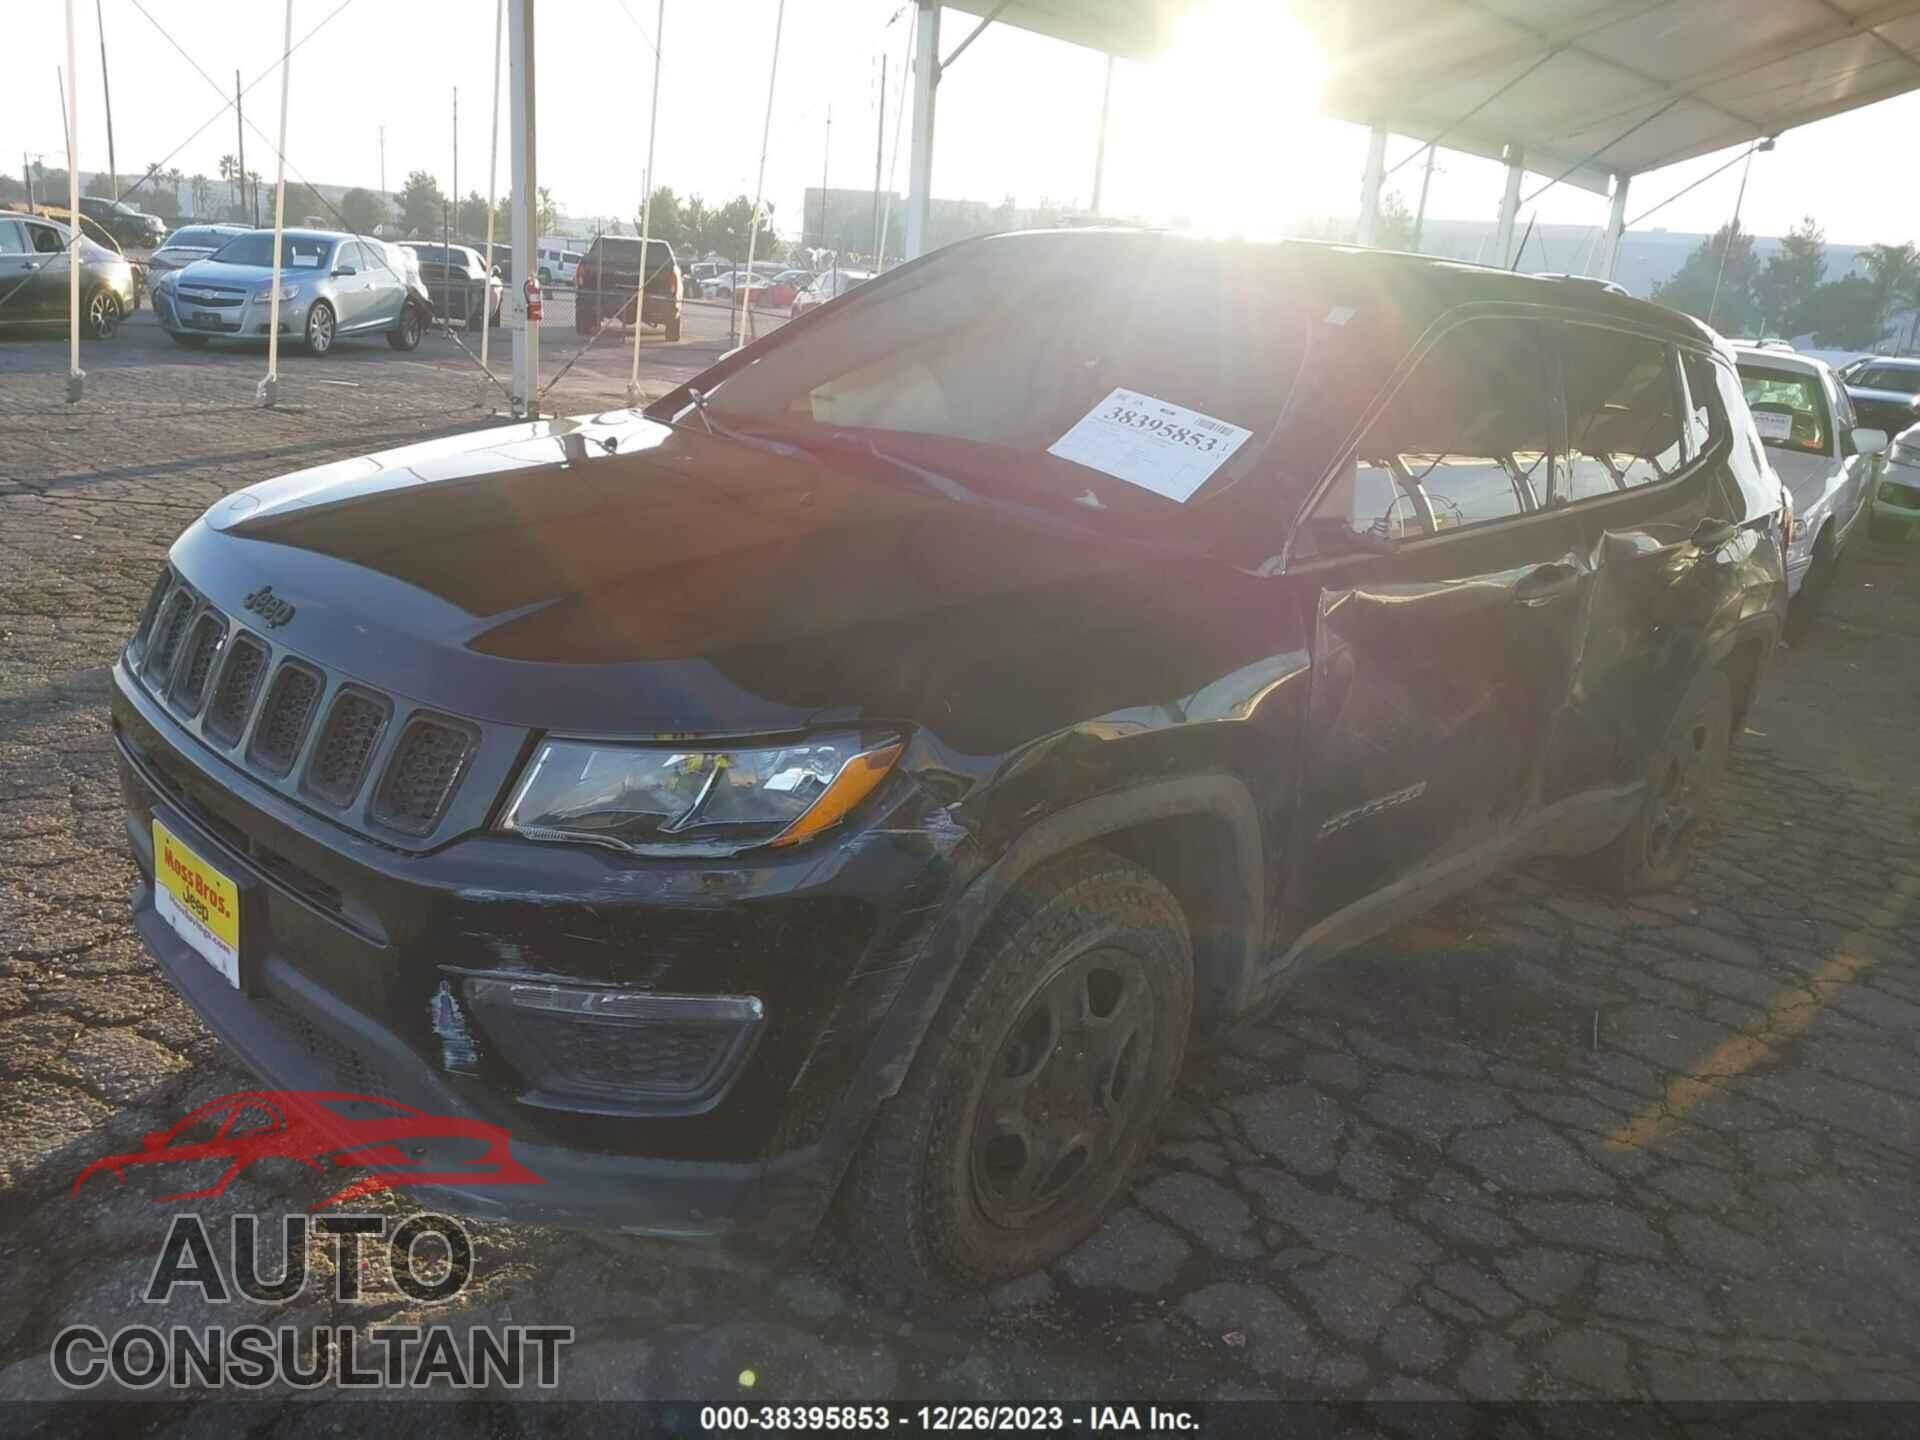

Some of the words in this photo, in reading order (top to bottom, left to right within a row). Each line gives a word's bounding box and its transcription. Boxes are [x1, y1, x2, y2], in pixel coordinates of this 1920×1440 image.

[1103, 407, 1217, 451] 38395853
[244, 585, 296, 629] Jeep
[182, 886, 209, 922] Jeep
